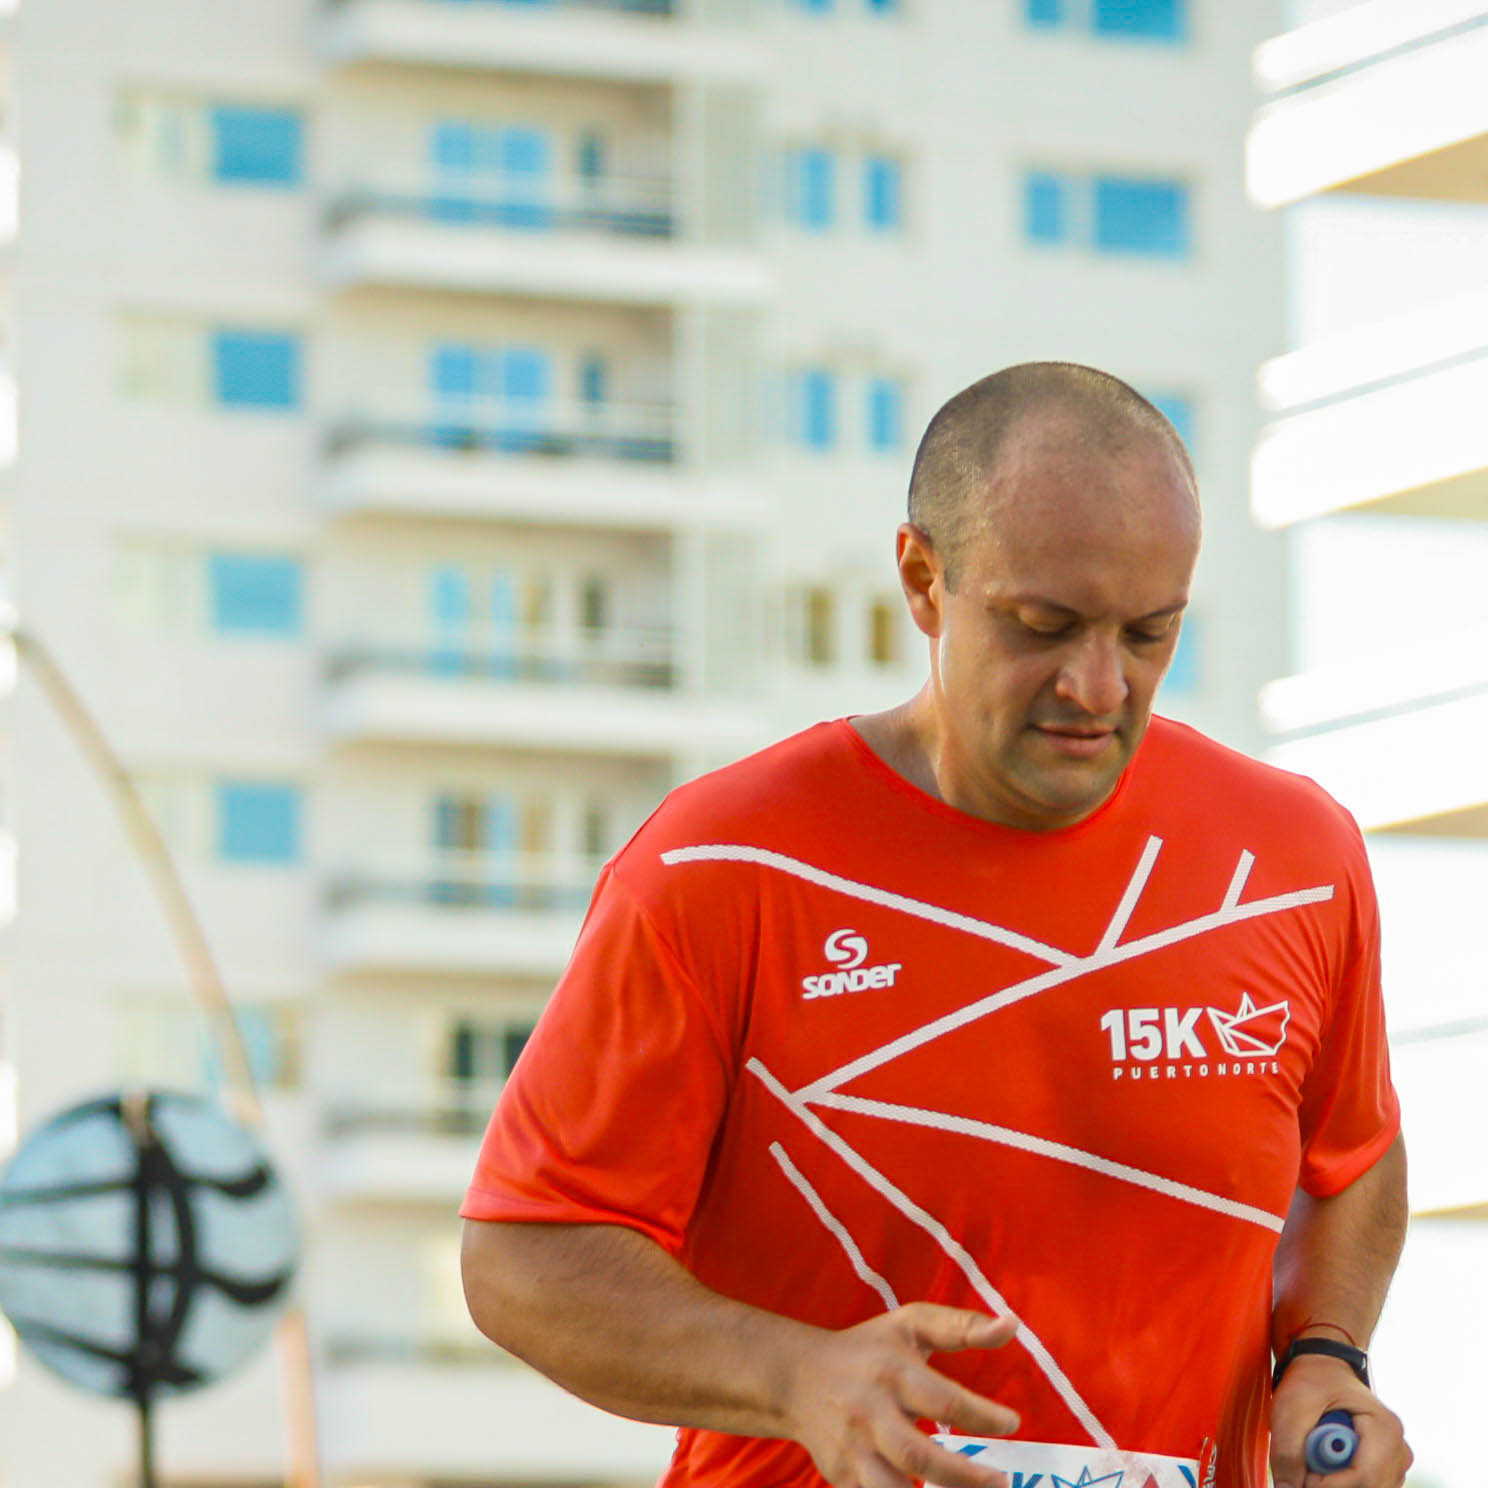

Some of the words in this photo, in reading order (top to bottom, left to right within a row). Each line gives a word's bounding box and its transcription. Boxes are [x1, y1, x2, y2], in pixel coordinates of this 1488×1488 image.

[1100, 1007, 1207, 1061] 15K
[1113, 1063, 1209, 1080] PUERTO
[1217, 1061, 1279, 1076] NORTE
